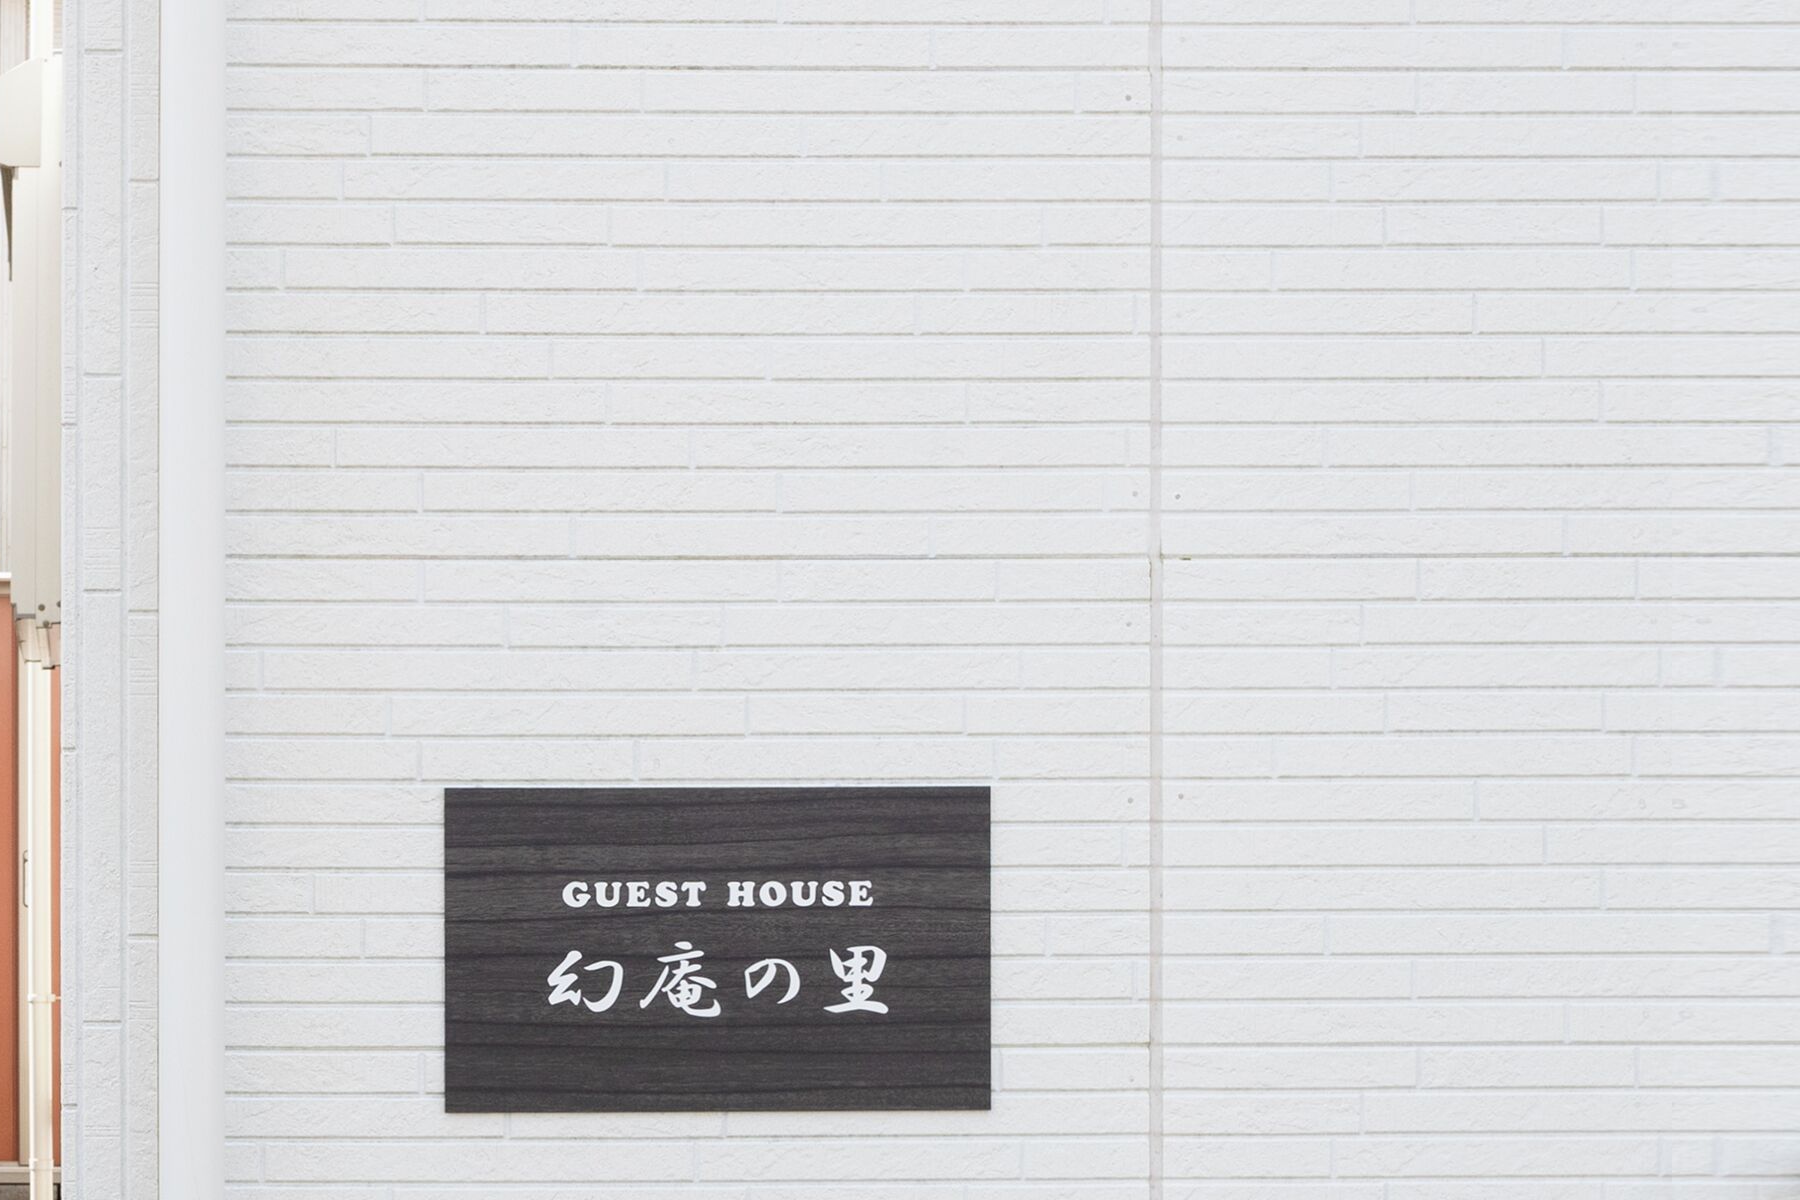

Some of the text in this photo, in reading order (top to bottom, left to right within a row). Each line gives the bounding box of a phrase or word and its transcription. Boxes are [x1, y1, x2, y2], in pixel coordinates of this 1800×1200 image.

[561, 880, 874, 908] GUEST HOUSE
[546, 940, 890, 1018] 幻庵の里
